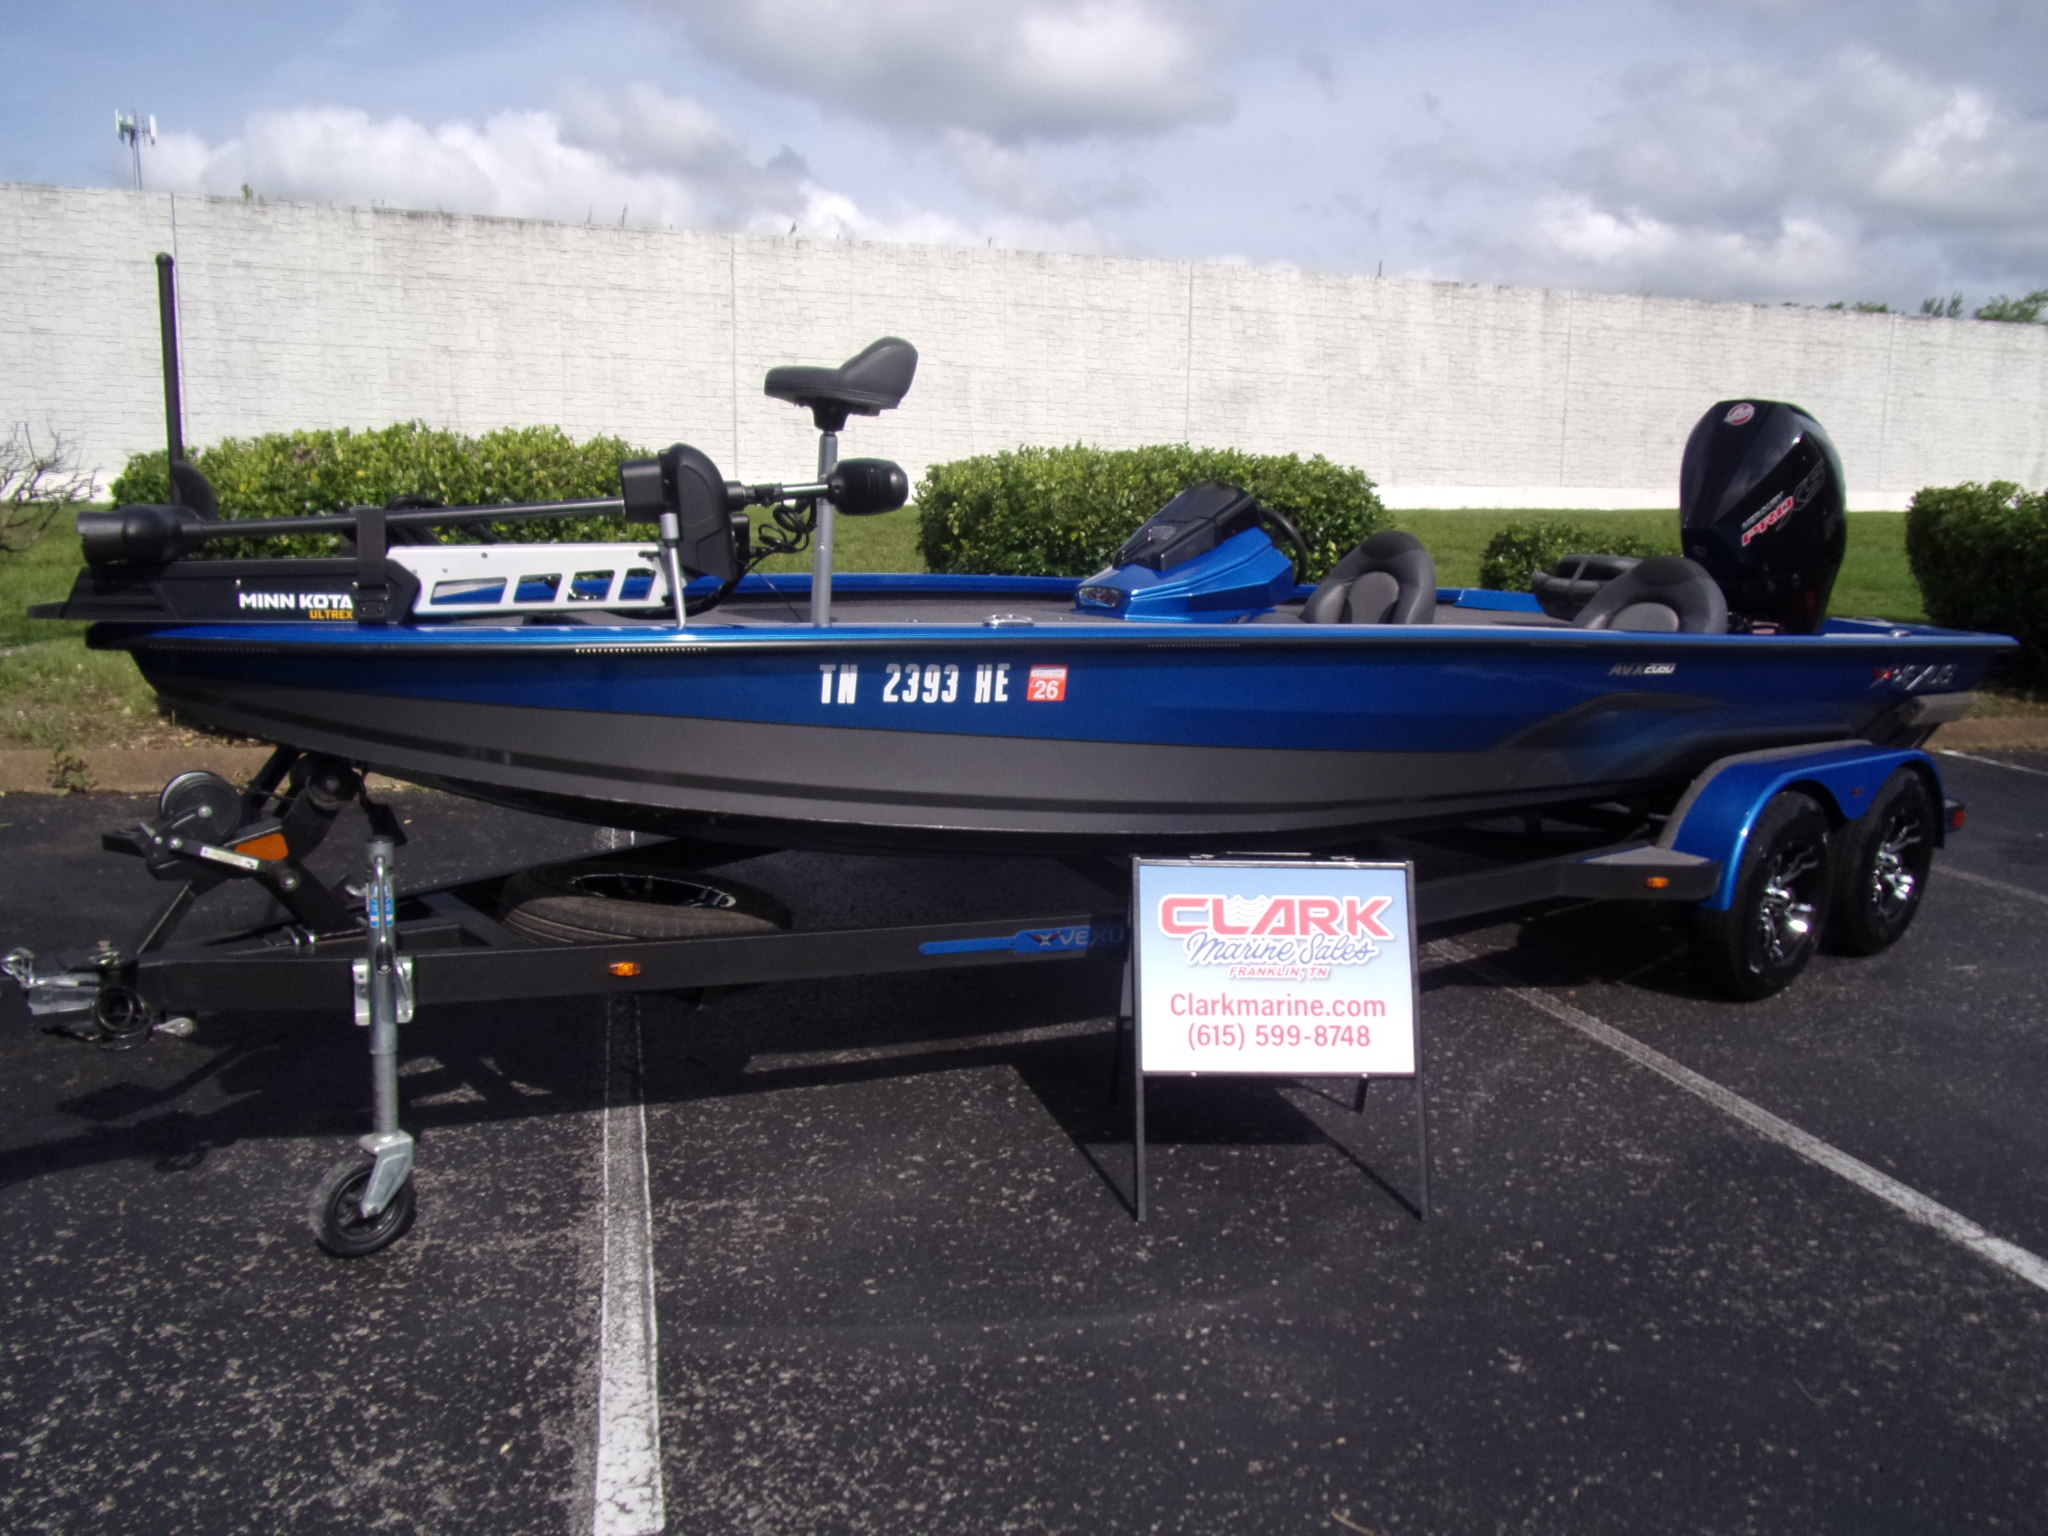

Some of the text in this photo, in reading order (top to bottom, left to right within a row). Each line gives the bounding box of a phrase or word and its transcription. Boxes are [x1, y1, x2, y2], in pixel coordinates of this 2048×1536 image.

[238, 592, 354, 610] MINN KOTA
[308, 609, 353, 620] ULTREX
[819, 663, 1011, 704] TN 2393 HE
[1033, 679, 1059, 700] 26
[1161, 896, 1391, 937] CLARK
[1186, 931, 1377, 965] Marine Sales
[1229, 966, 1329, 979] FRANKLIN, TN
[1169, 992, 1387, 1017] Clarkmarine.com
[1187, 1022, 1371, 1051] (615) 599-8748
